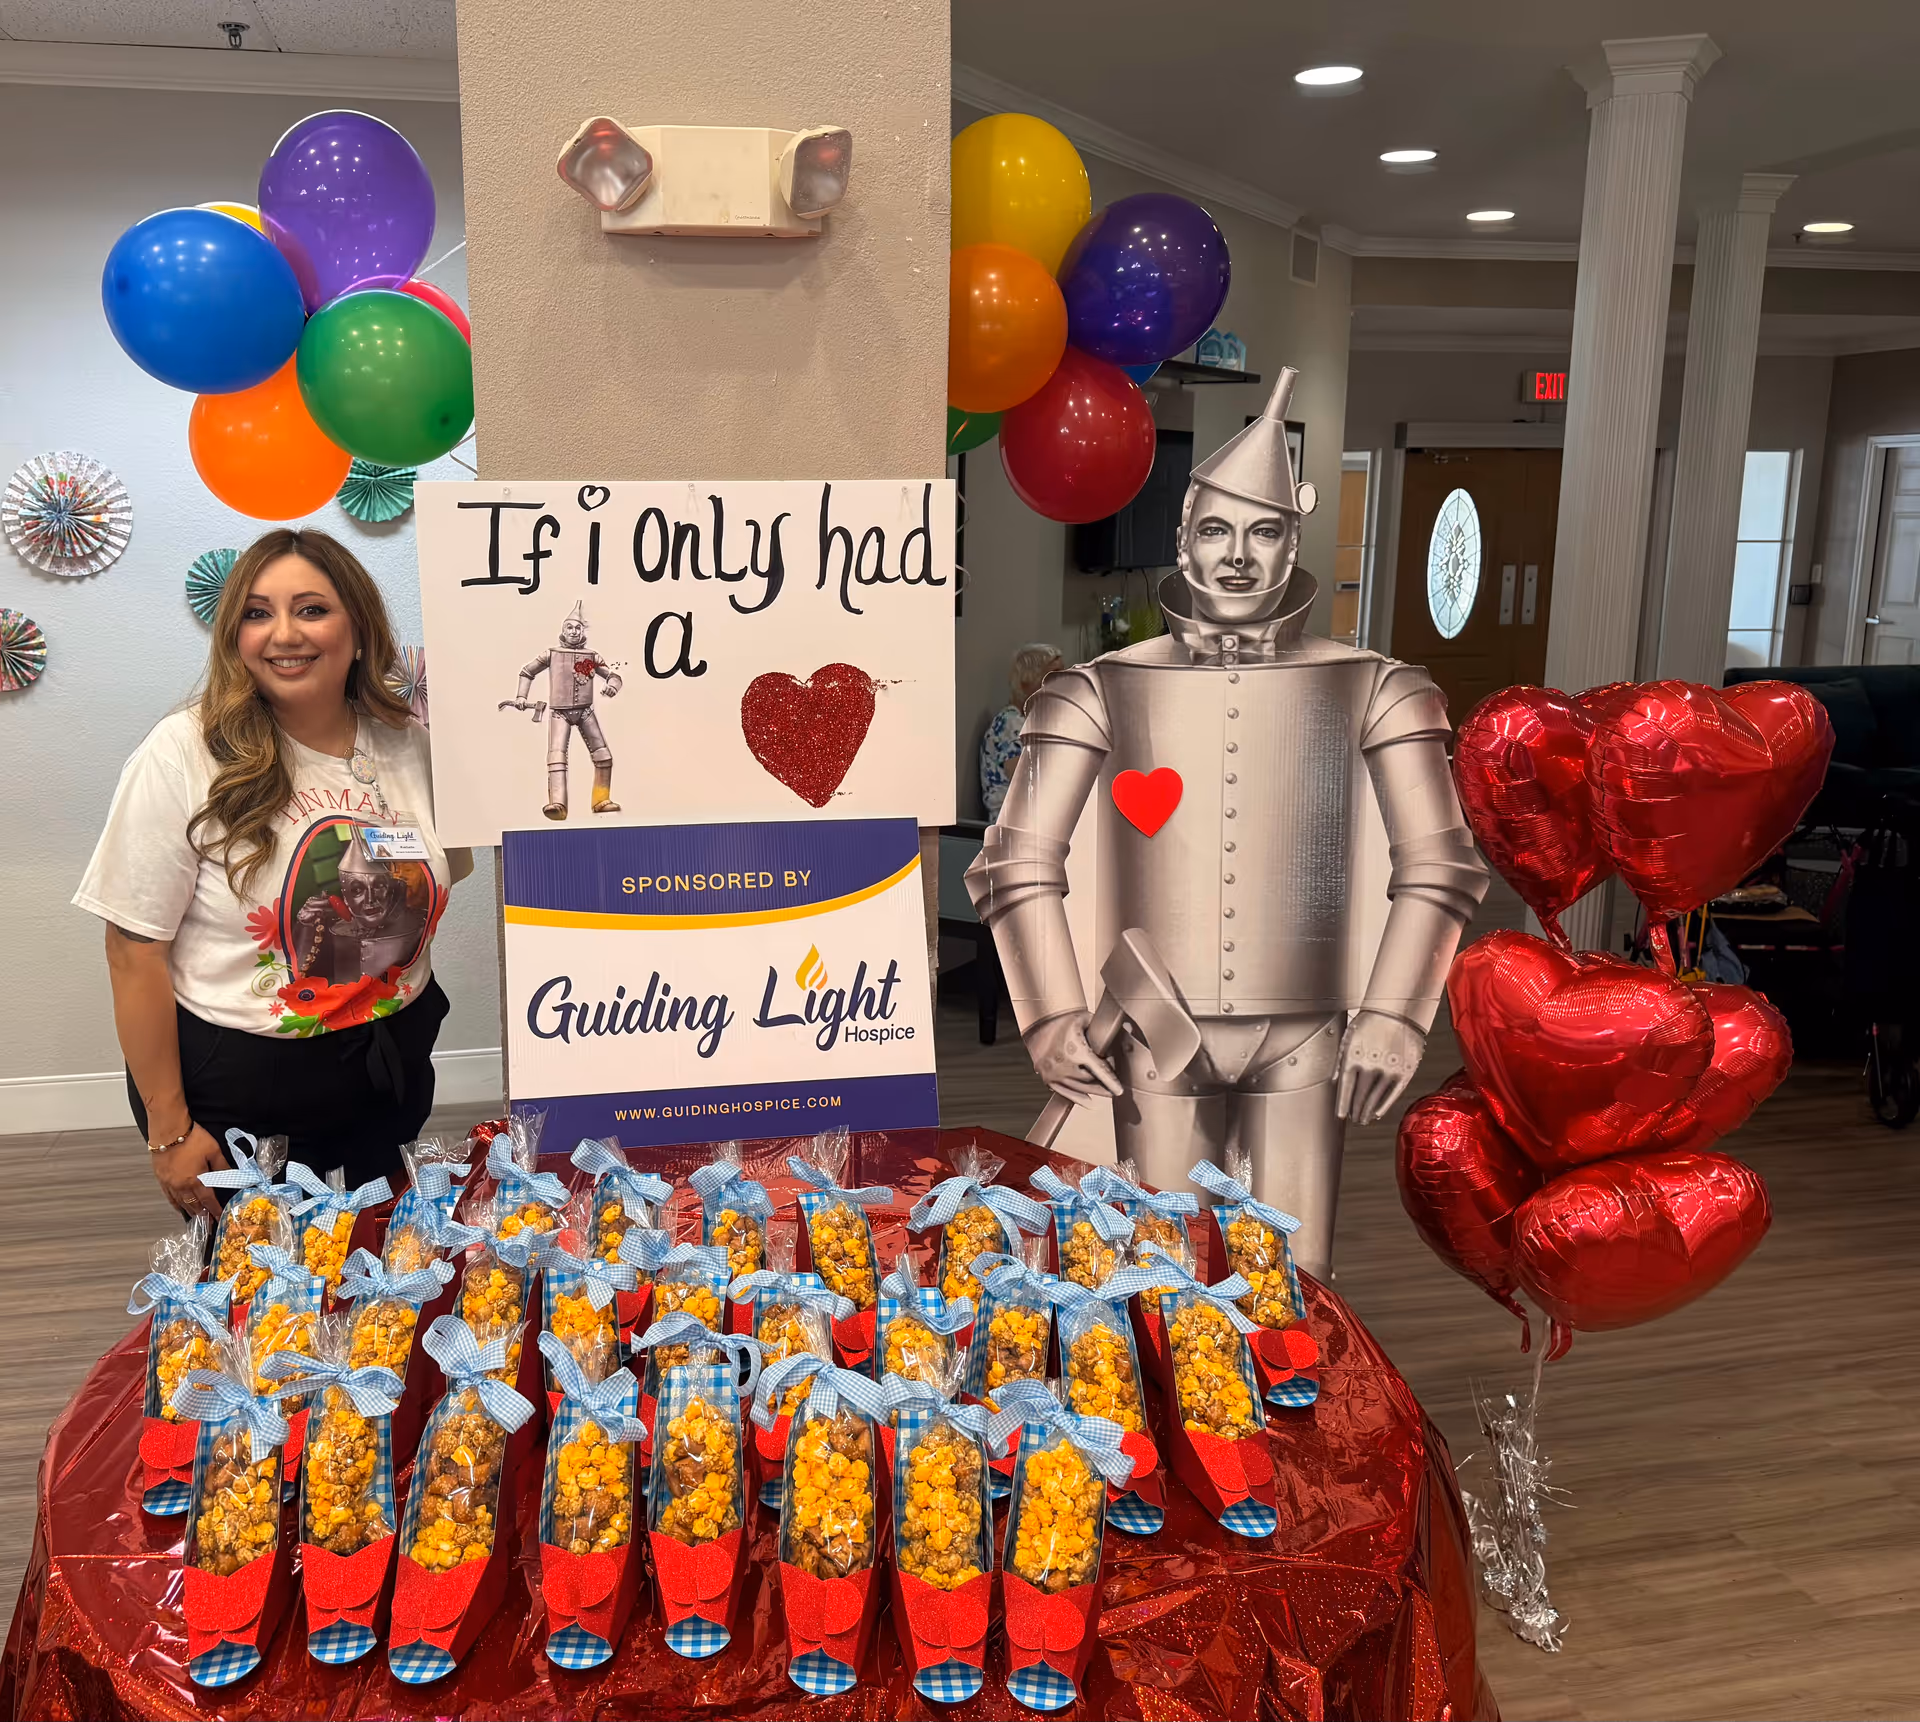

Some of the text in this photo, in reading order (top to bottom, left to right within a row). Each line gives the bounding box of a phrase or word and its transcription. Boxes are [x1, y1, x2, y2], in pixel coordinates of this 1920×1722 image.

[1536, 372, 1567, 400] EXIT
[457, 501, 561, 595] If
[577, 484, 611, 585] i
[815, 482, 947, 614] had
[644, 611, 707, 679] a
[621, 869, 812, 894] SPONSORED BY
[526, 958, 901, 1059] Guiding Light
[844, 1024, 916, 1046] Hospice
[614, 1095, 842, 1122] WWW.GUIDINGHOSPICE.COM
